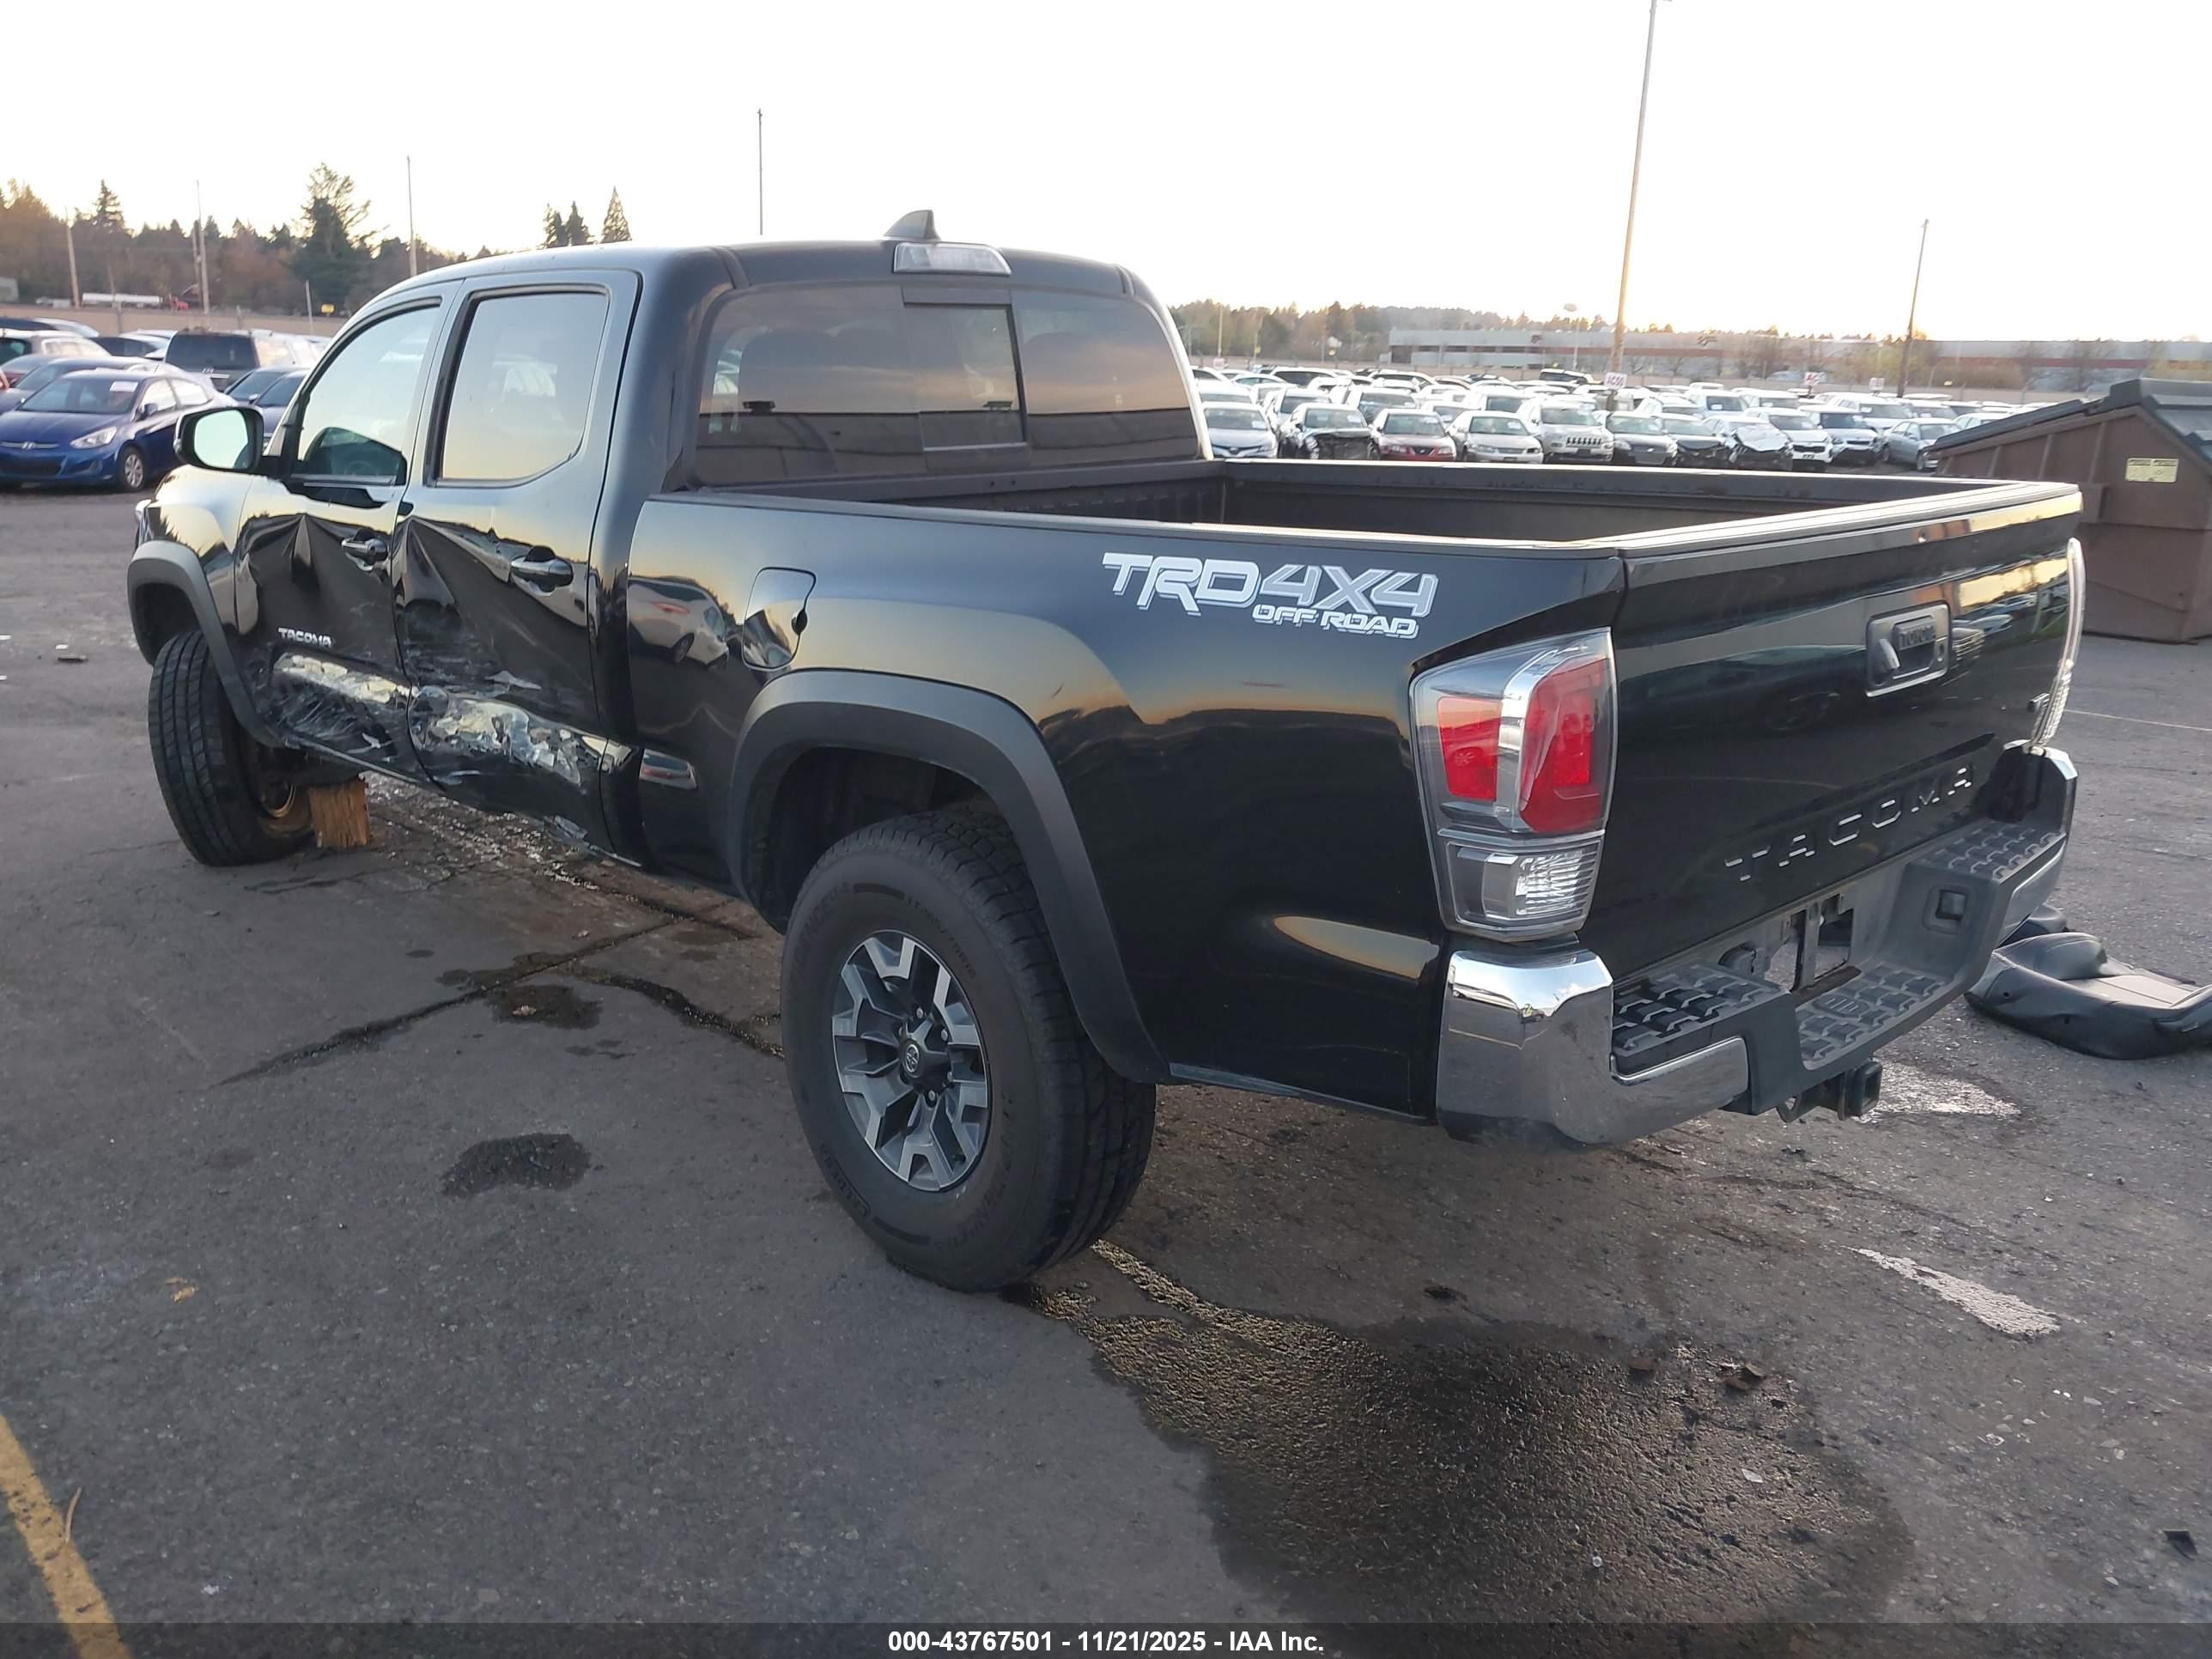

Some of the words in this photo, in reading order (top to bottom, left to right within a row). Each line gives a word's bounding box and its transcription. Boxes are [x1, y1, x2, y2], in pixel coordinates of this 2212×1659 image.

[1103, 552, 1262, 617] TRD
[1259, 564, 1439, 617] 4X4
[277, 628, 332, 647] TACOMA
[1252, 604, 1319, 627] OFF
[1320, 611, 1419, 639] ROAD
[1724, 763, 1973, 882] TACOMA
